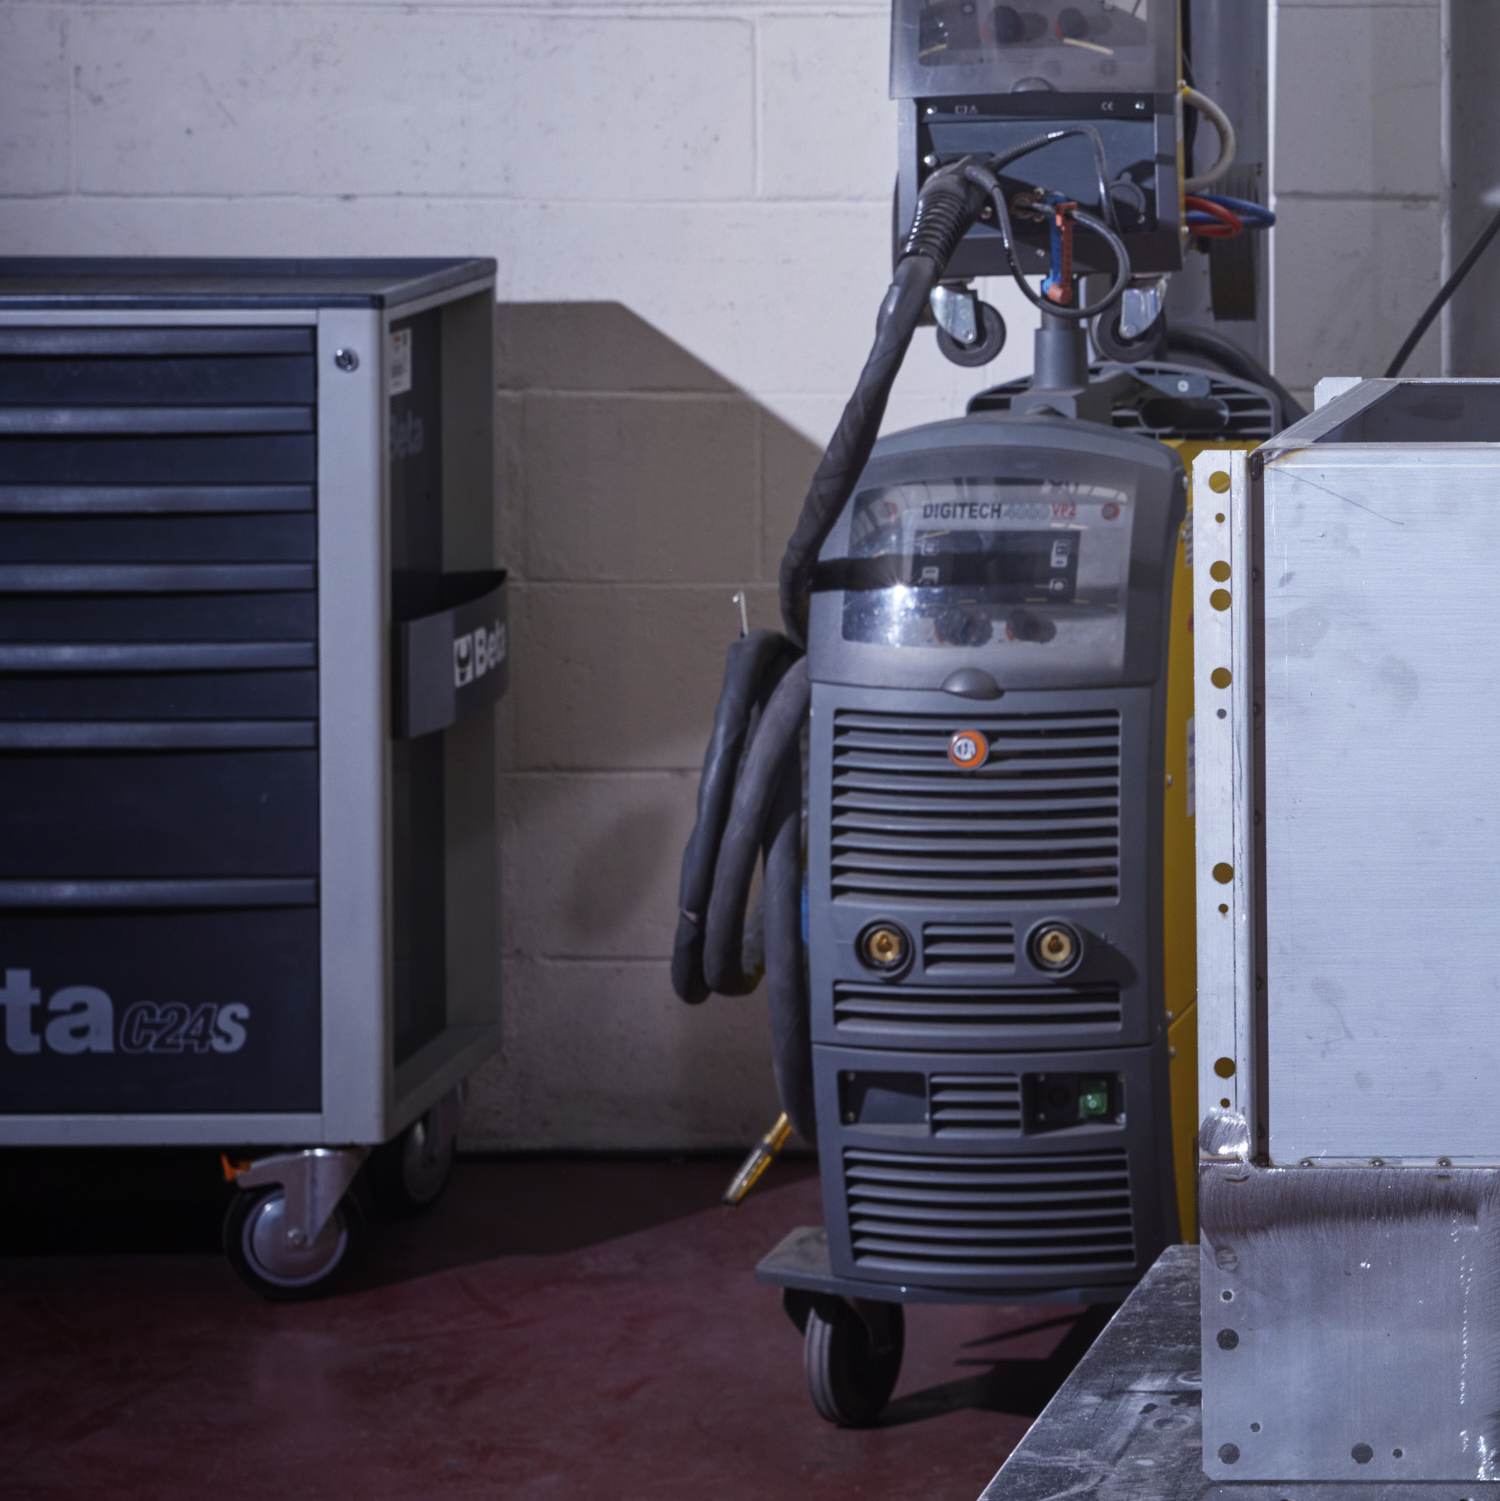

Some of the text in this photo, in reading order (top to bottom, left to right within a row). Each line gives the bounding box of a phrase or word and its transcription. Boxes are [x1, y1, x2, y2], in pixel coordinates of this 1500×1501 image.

[922, 502, 1002, 520] DIGITECH
[1051, 503, 1077, 518] VP2
[474, 619, 507, 679] Beta
[119, 999, 250, 1055] C24S
